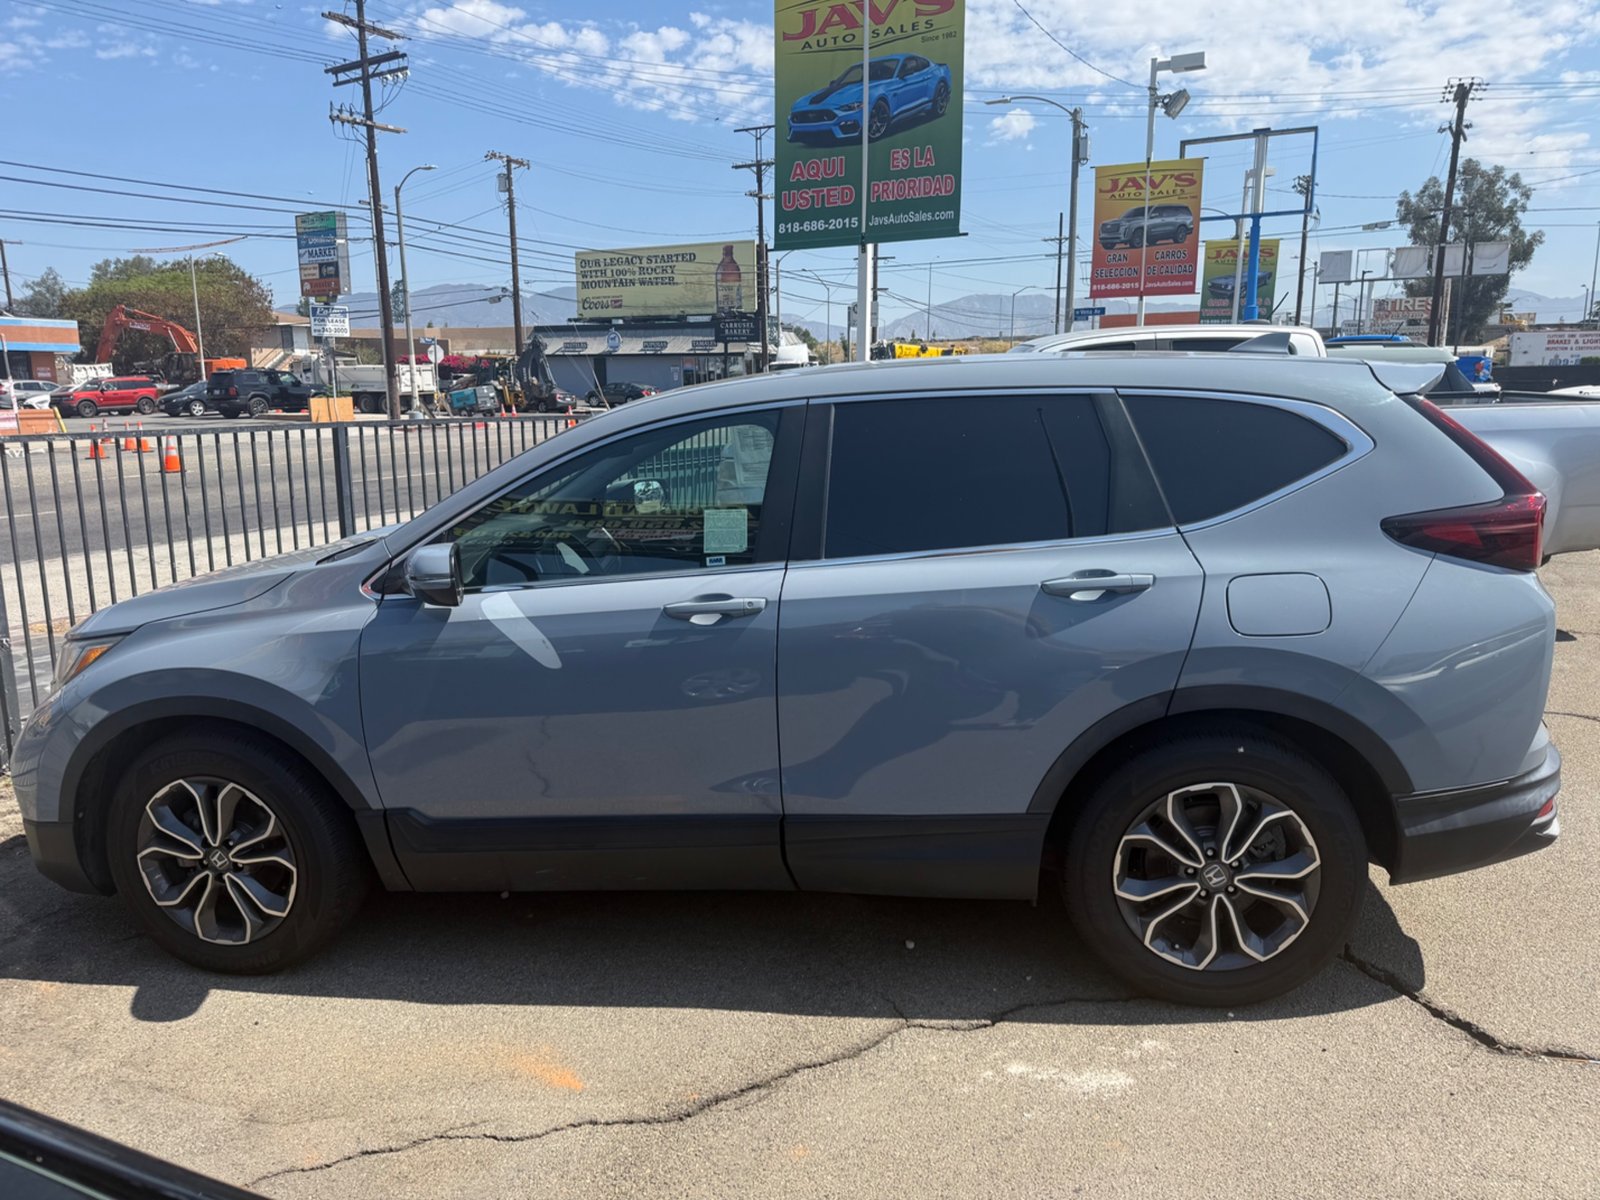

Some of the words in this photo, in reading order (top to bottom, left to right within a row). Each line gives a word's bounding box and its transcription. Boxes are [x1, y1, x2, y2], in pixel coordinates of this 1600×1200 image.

[800, 33, 856, 50] AUTO
[871, 19, 934, 39] SALES
[921, 34, 940, 44] Since
[790, 156, 846, 182] AQUI
[889, 148, 911, 170] ES
[914, 146, 936, 168] LA
[1099, 172, 1198, 194] JAV'S
[782, 184, 856, 211] USTED
[870, 174, 955, 202] PRIORIDAD
[1108, 191, 1144, 200] AUTO
[1149, 188, 1186, 196] SALES
[778, 217, 858, 234] 818-686-2015
[868, 209, 954, 226] JavsAutoSales.com
[307, 246, 336, 259] MARKET
[1106, 253, 1128, 264] GRAN
[1154, 250, 1188, 260] CARROS
[580, 258, 601, 269] OUR
[604, 256, 644, 267] LEGACY
[646, 252, 696, 264] STARTED
[580, 268, 607, 280] WITH
[611, 266, 636, 278] 100%
[638, 265, 676, 276] ROCKY
[1094, 268, 1138, 279] SELECCION
[1146, 266, 1158, 276] DE
[1159, 264, 1194, 274] CALIDAD
[581, 278, 636, 290] MOUNTAIN
[1092, 282, 1139, 290] 818-686-2015
[582, 298, 610, 310] Coors
